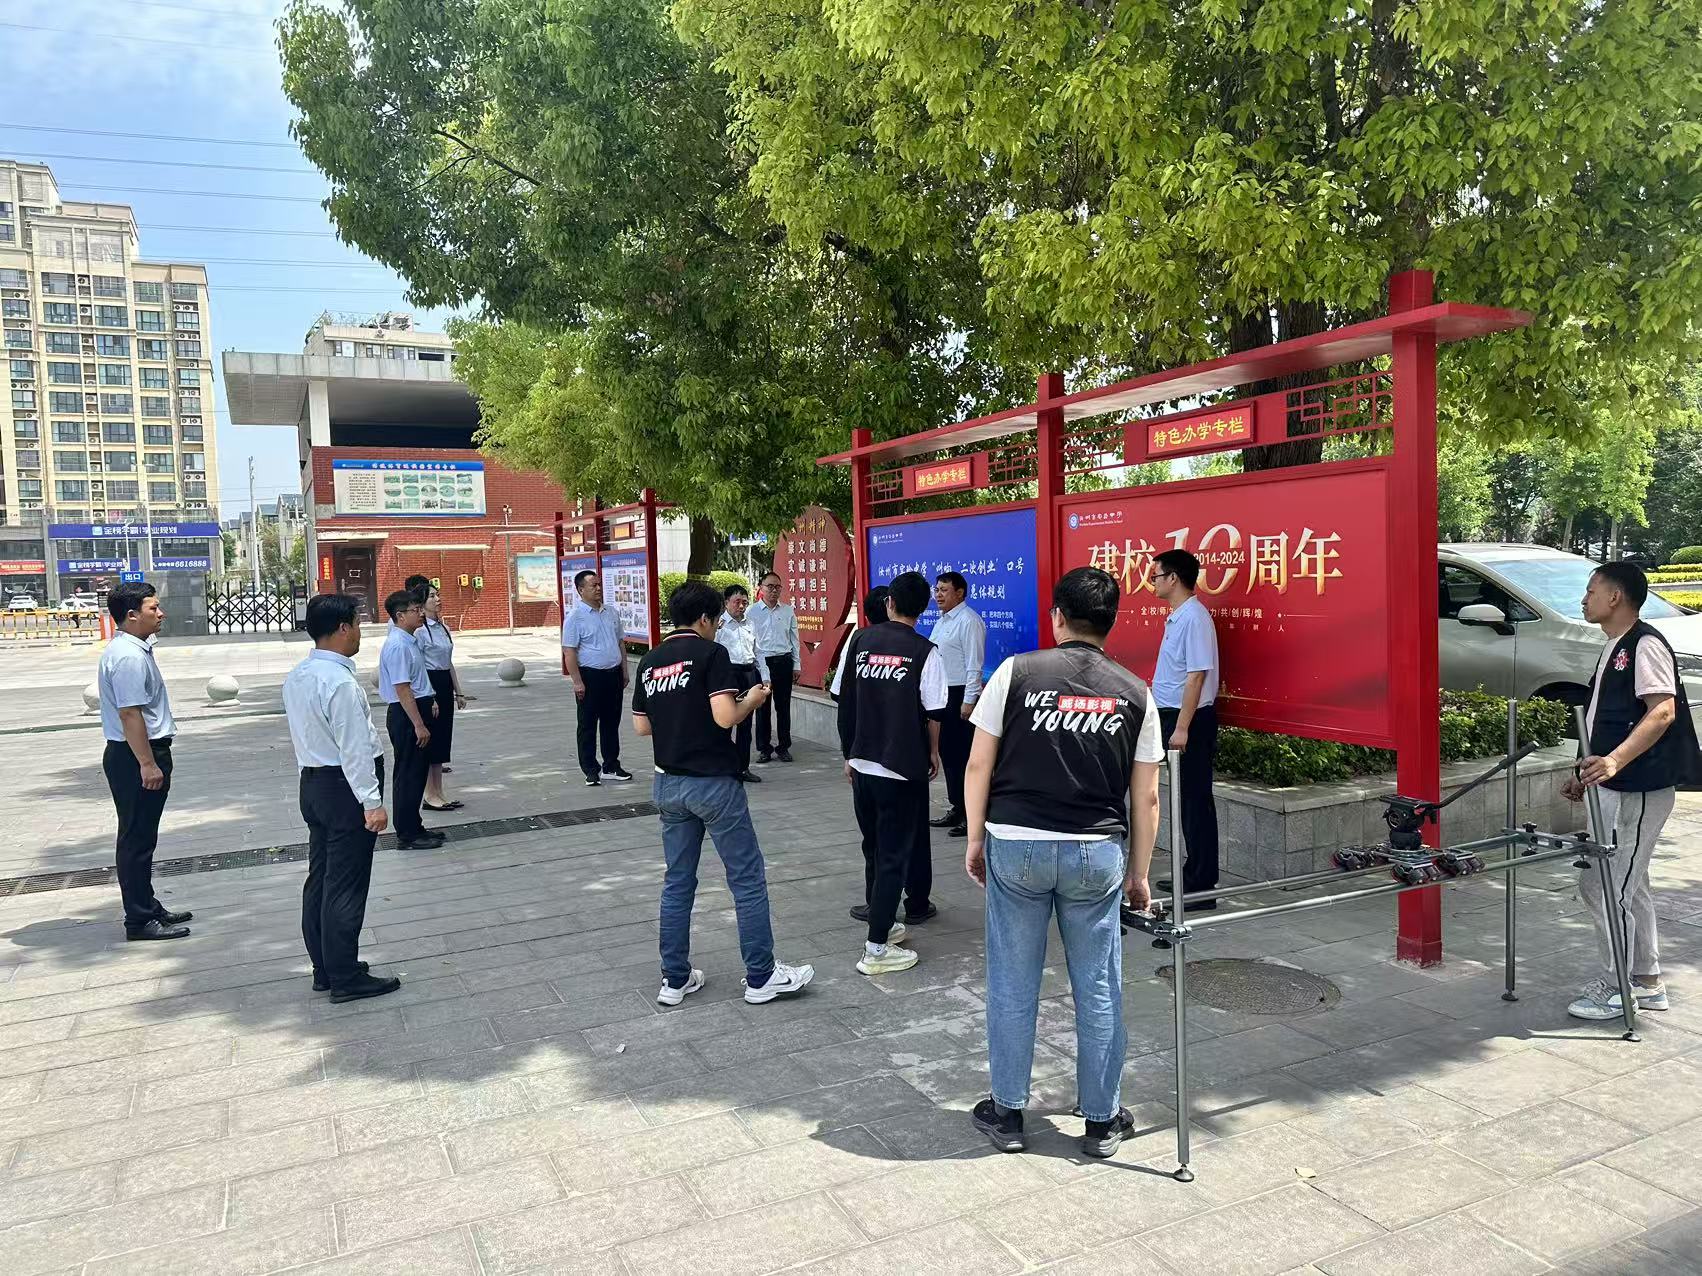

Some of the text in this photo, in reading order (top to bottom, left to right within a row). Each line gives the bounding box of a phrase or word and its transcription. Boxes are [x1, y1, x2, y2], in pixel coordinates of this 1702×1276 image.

[1153, 416, 1244, 447] 特色办学专栏
[918, 467, 966, 487] 特色办学专栏
[791, 516, 826, 535] 州精神
[788, 538, 827, 555] 崇文尚德
[125, 573, 141, 581] 出口
[789, 577, 827, 592] 开明担当
[856, 664, 908, 682] YOUNG
[645, 671, 691, 698] YOUNG
[1024, 690, 1058, 708] WE
[1031, 709, 1124, 736] YOUNG
